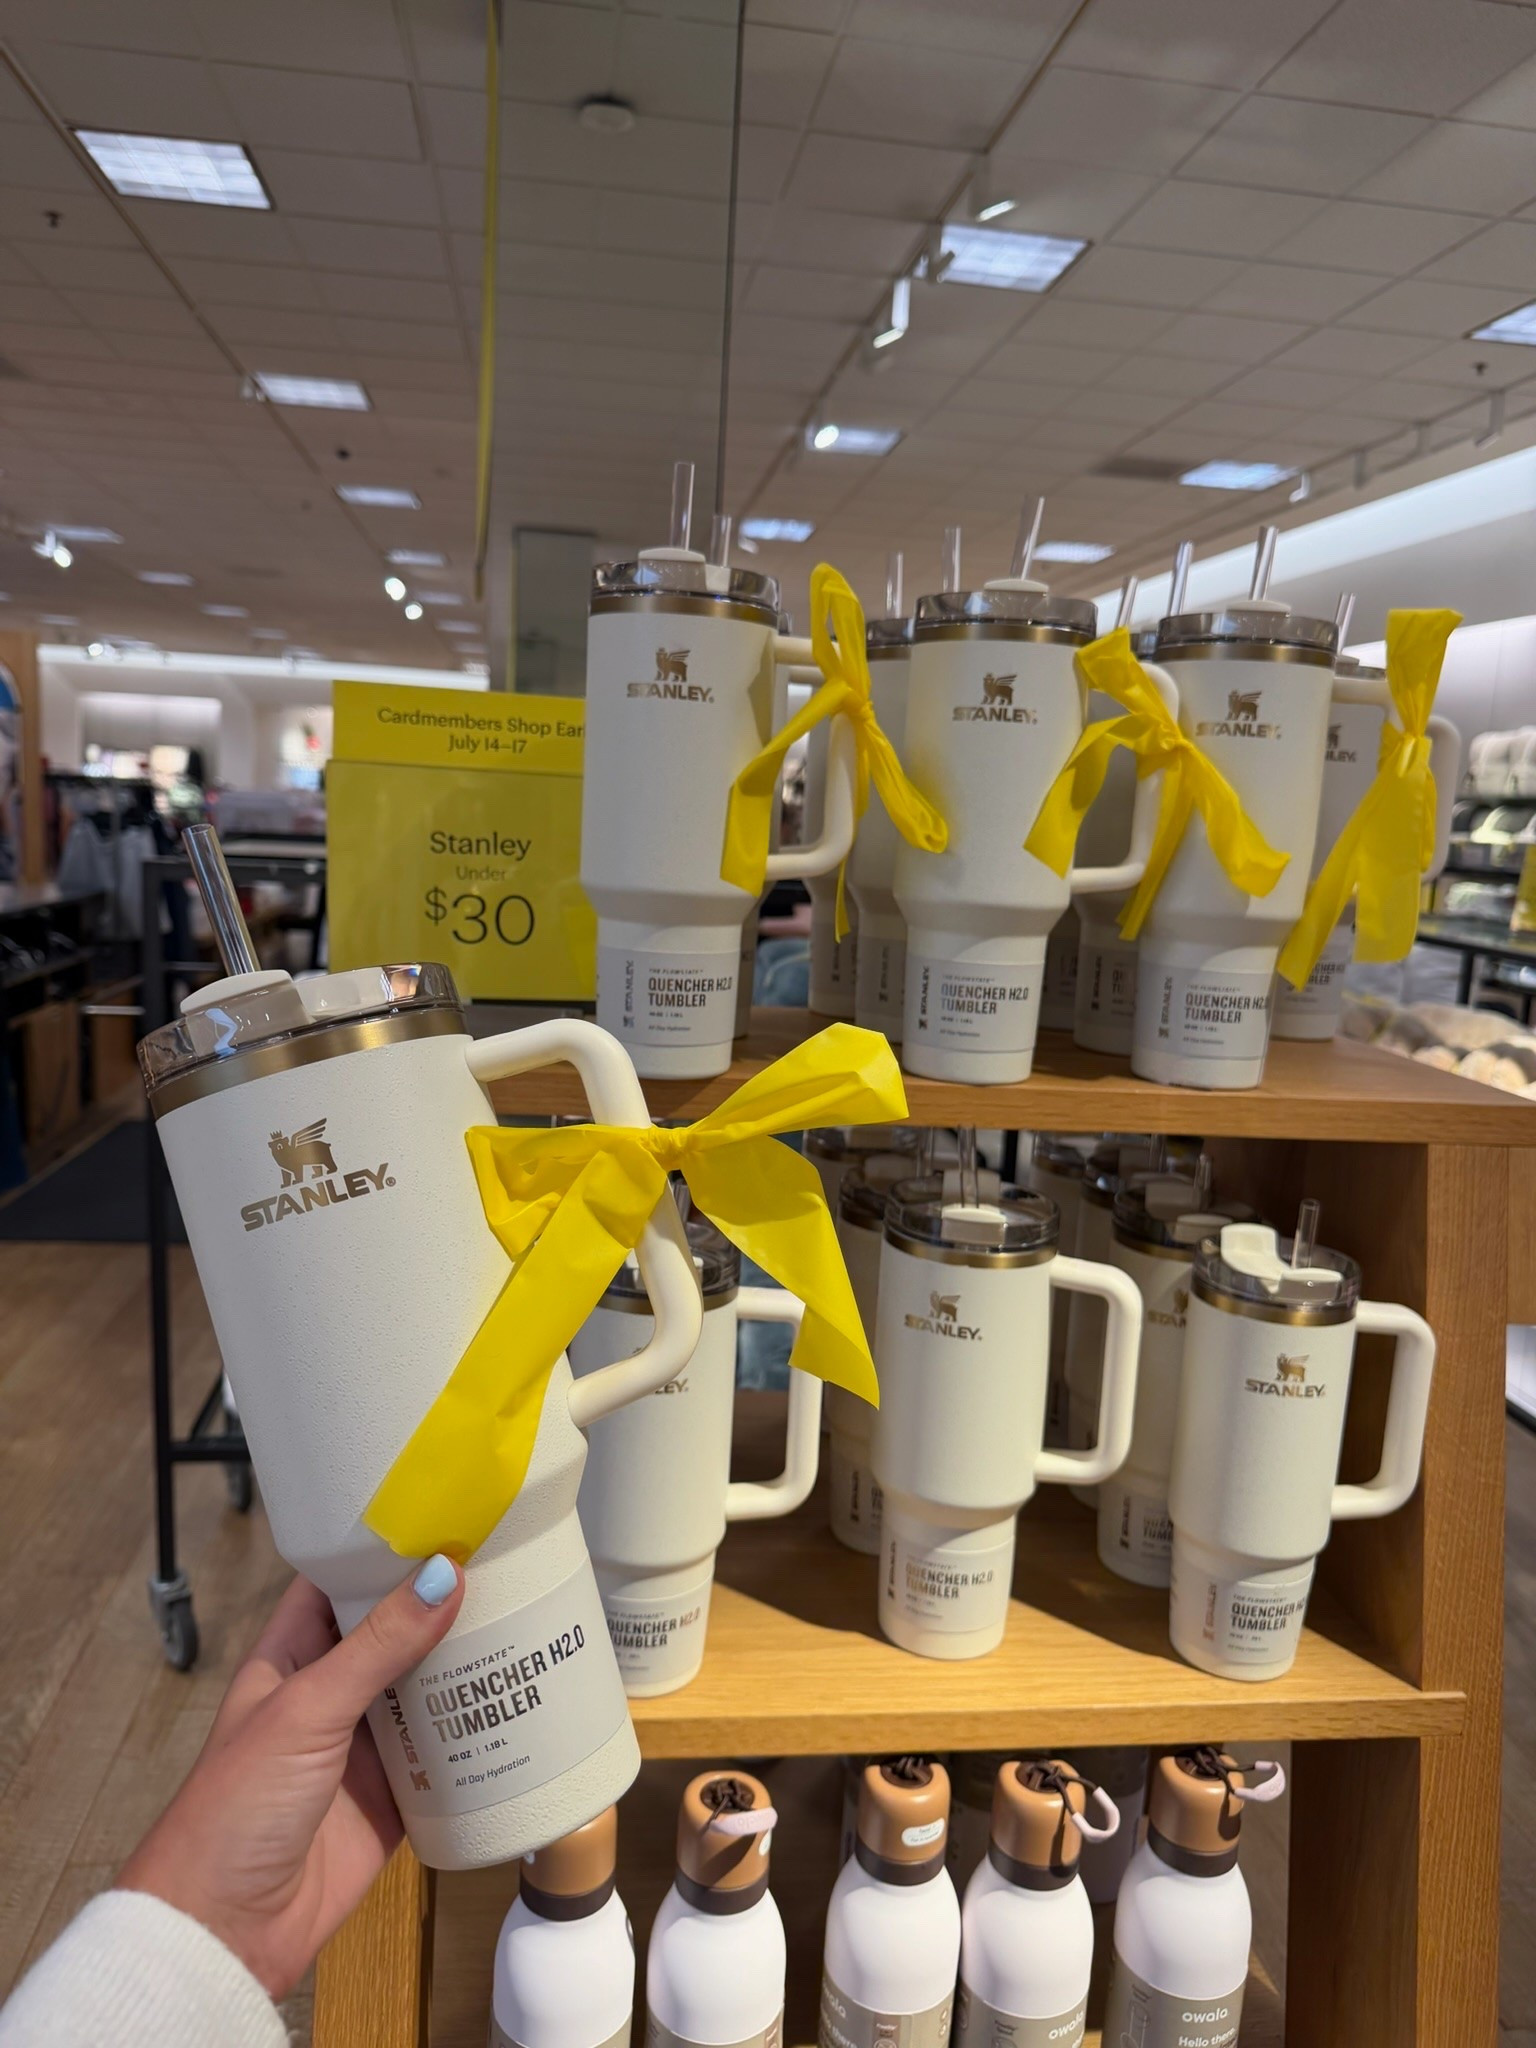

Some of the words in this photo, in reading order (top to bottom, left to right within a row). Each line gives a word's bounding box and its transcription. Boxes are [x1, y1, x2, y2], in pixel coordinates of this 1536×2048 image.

[627, 683, 713, 702] STANLEY
[377, 707, 502, 731] Cardmembers
[507, 717, 552, 738] Shop
[952, 706, 1036, 723] STANLEY
[448, 733, 480, 753] July
[430, 830, 532, 861] Stanley
[456, 866, 505, 881] Under
[424, 886, 535, 946] $30
[648, 977, 714, 992] QUENCHER
[941, 983, 1006, 1000] QUENCHER
[1008, 986, 1029, 1001] H2.0
[648, 992, 706, 1008] TUMBLER
[941, 998, 997, 1015] TUMBLER
[1185, 992, 1251, 1010] QUENCHER
[1184, 1007, 1242, 1024] TUMBLER
[904, 1314, 980, 1340] STANLEY
[1244, 1378, 1325, 1398] STANLEY
[1231, 1602, 1295, 1618] QUENCHER
[607, 1618, 677, 1634] QUENCHER
[1231, 1615, 1286, 1631] TUMBLER
[612, 1633, 667, 1649] UMBLER
[425, 1650, 548, 1717] QUENCHER
[549, 1624, 585, 1665] H2.0
[419, 1674, 440, 1687] THE
[432, 1684, 542, 1743] TUMBLER
[385, 1687, 420, 1764] STANLE
[448, 1754, 459, 1763] 40
[460, 1750, 472, 1760] OZ
[485, 1740, 501, 1752] 1.18
[501, 1738, 508, 1746] L
[456, 1777, 467, 1787] All
[468, 1773, 485, 1783] Day
[486, 1755, 531, 1778] Hydration
[1182, 2007, 1228, 2023] owala
[1179, 2036, 1209, 2047] Hello
